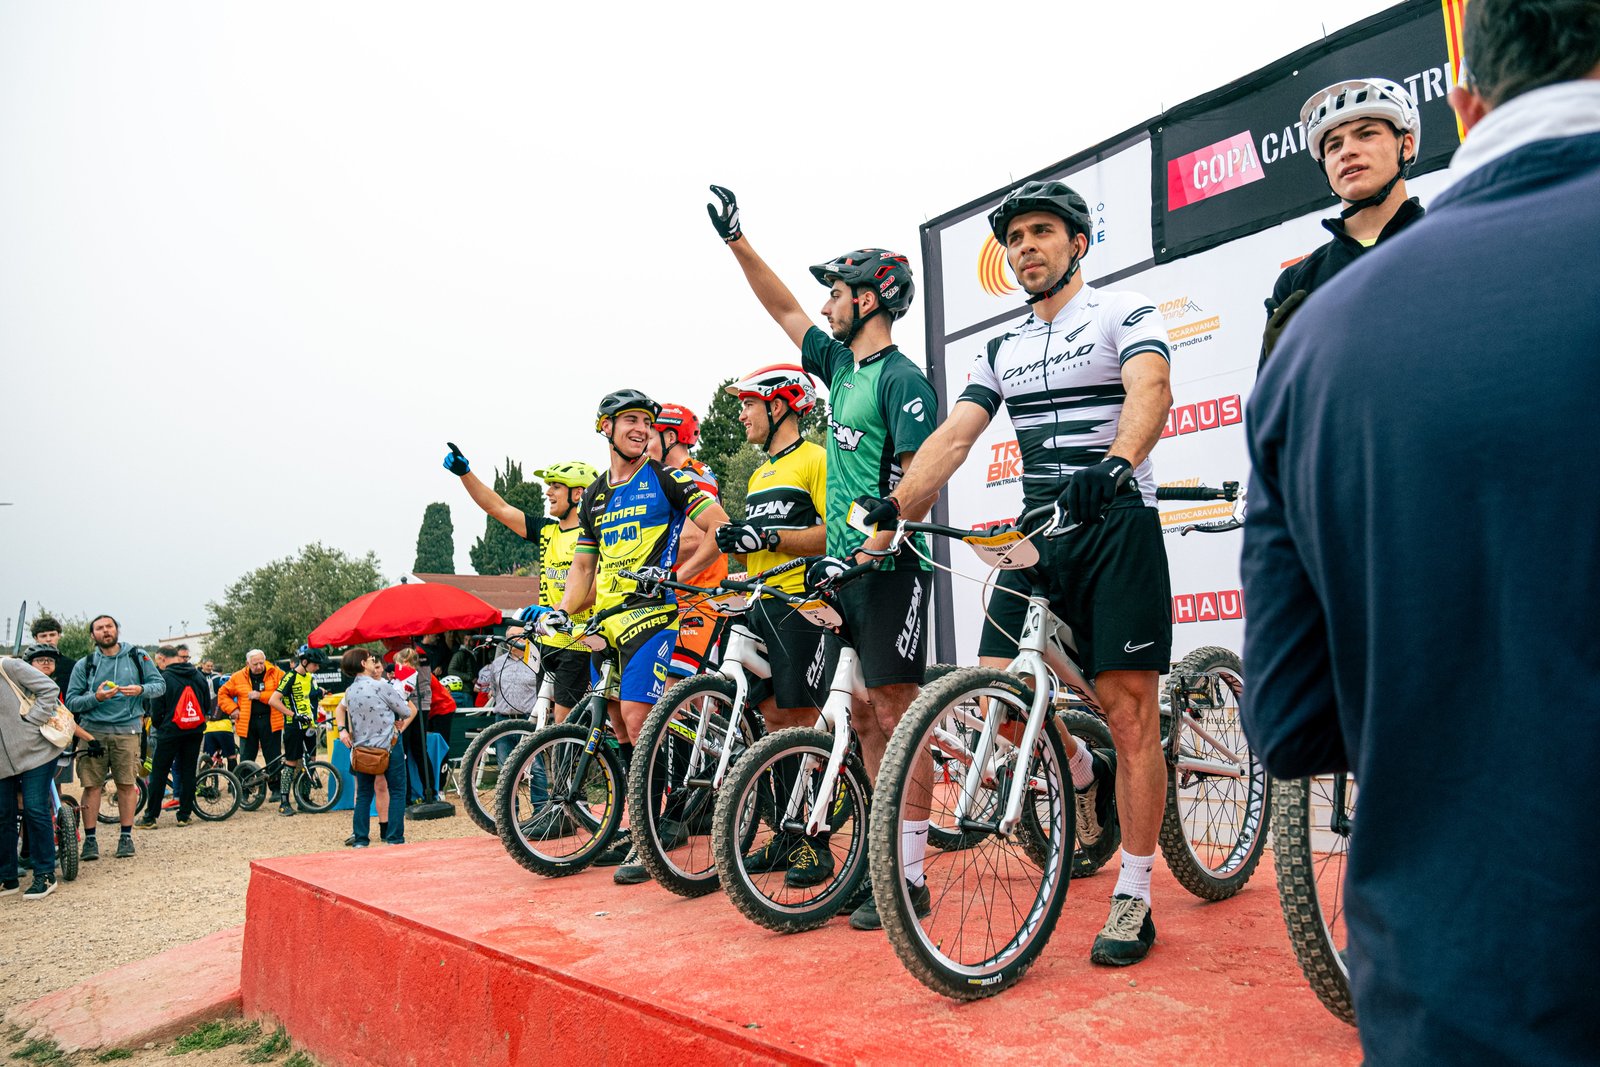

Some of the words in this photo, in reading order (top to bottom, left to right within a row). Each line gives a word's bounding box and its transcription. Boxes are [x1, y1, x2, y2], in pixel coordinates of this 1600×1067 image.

[1193, 142, 1257, 190] COPA
[1062, 359, 1092, 372] BIKES
[991, 440, 1022, 462] TR
[987, 459, 1024, 482] BIK
[595, 504, 647, 527] COMAS
[604, 526, 637, 547] WD-40
[898, 576, 922, 658] CLEAN
[620, 614, 669, 646] COMAS
[807, 633, 825, 687] CLE
